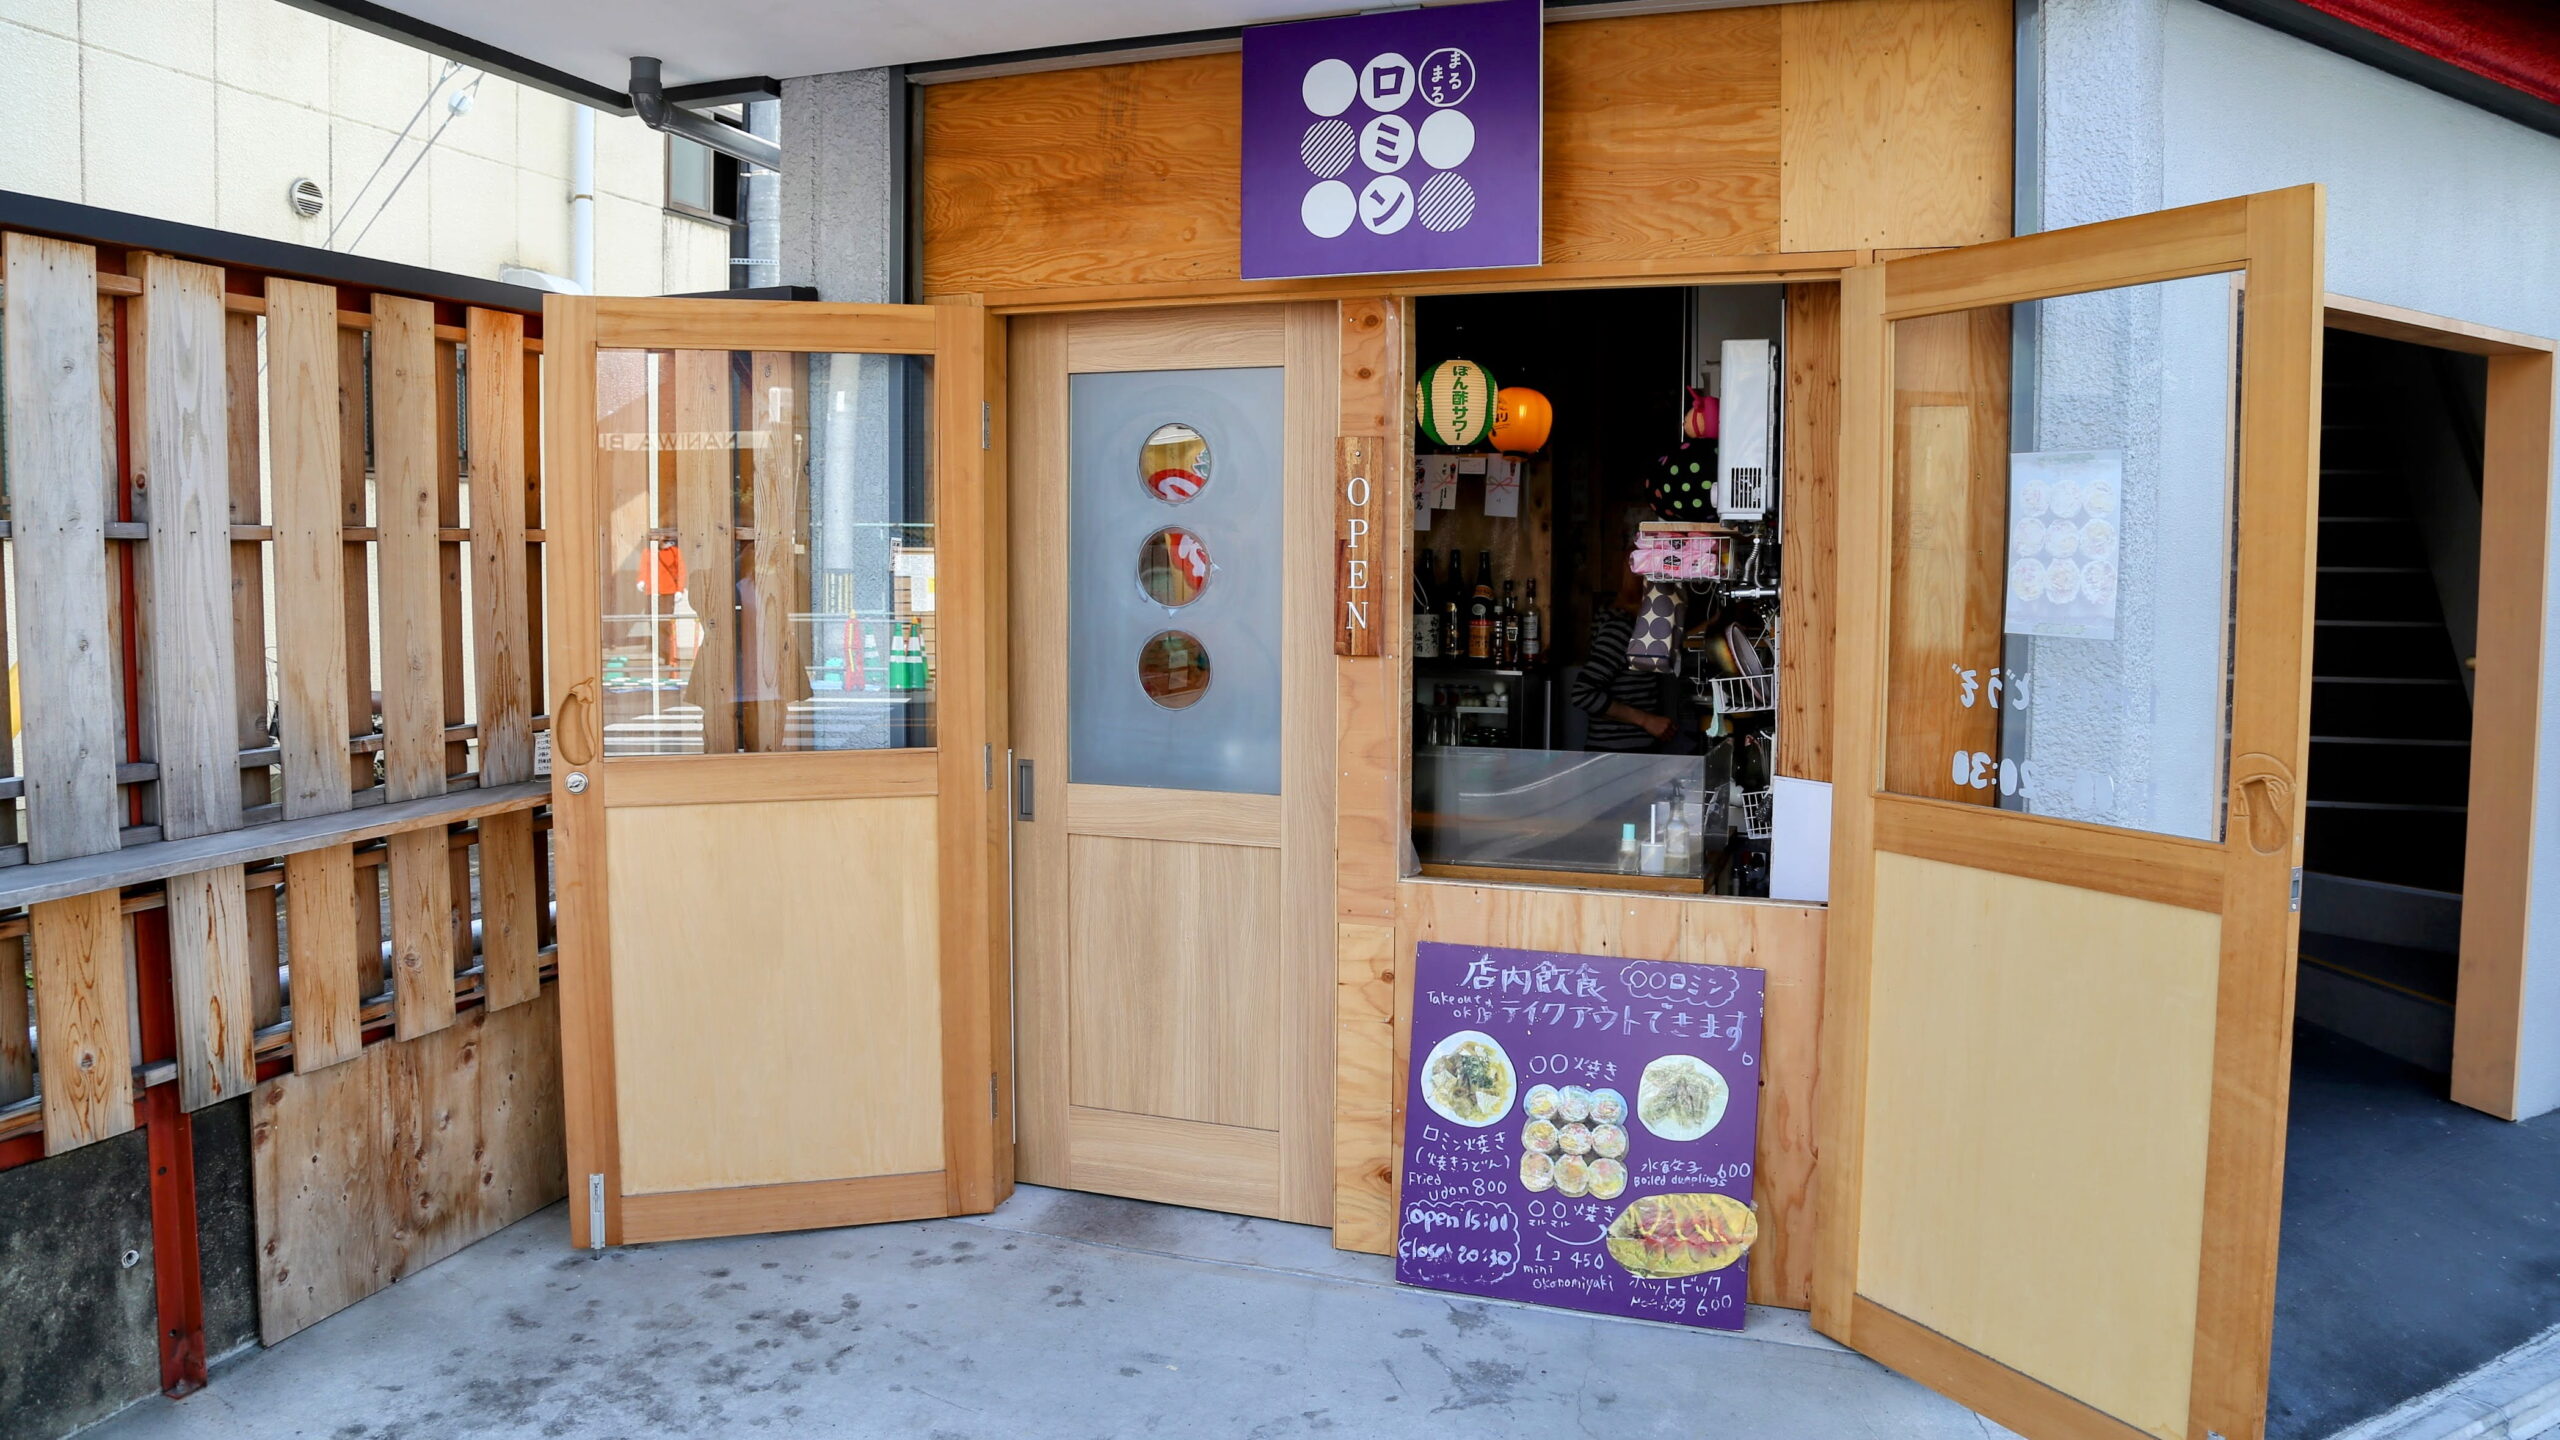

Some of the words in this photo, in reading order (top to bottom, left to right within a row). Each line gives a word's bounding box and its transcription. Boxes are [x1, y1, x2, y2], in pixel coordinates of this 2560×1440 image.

[1431, 64, 1444, 104] まる
[1449, 51, 1462, 90] まる
[1369, 65, 1406, 228] ロミン
[1451, 365, 1472, 441] ぽん酢サワー
[1345, 476, 1370, 630] OPEN
[1461, 953, 1608, 1002] 店内飲食
[1422, 1123, 1506, 1155] ロミン焼き
[1408, 1171, 1442, 1186] Fried
[1716, 1162, 1751, 1180] 600
[1472, 1177, 1508, 1197] 800
[1464, 1208, 1509, 1233] 15:00
[1457, 1245, 1513, 1268] 20:30
[1570, 1251, 1604, 1270] 450
[1696, 1294, 1732, 1317] 600
